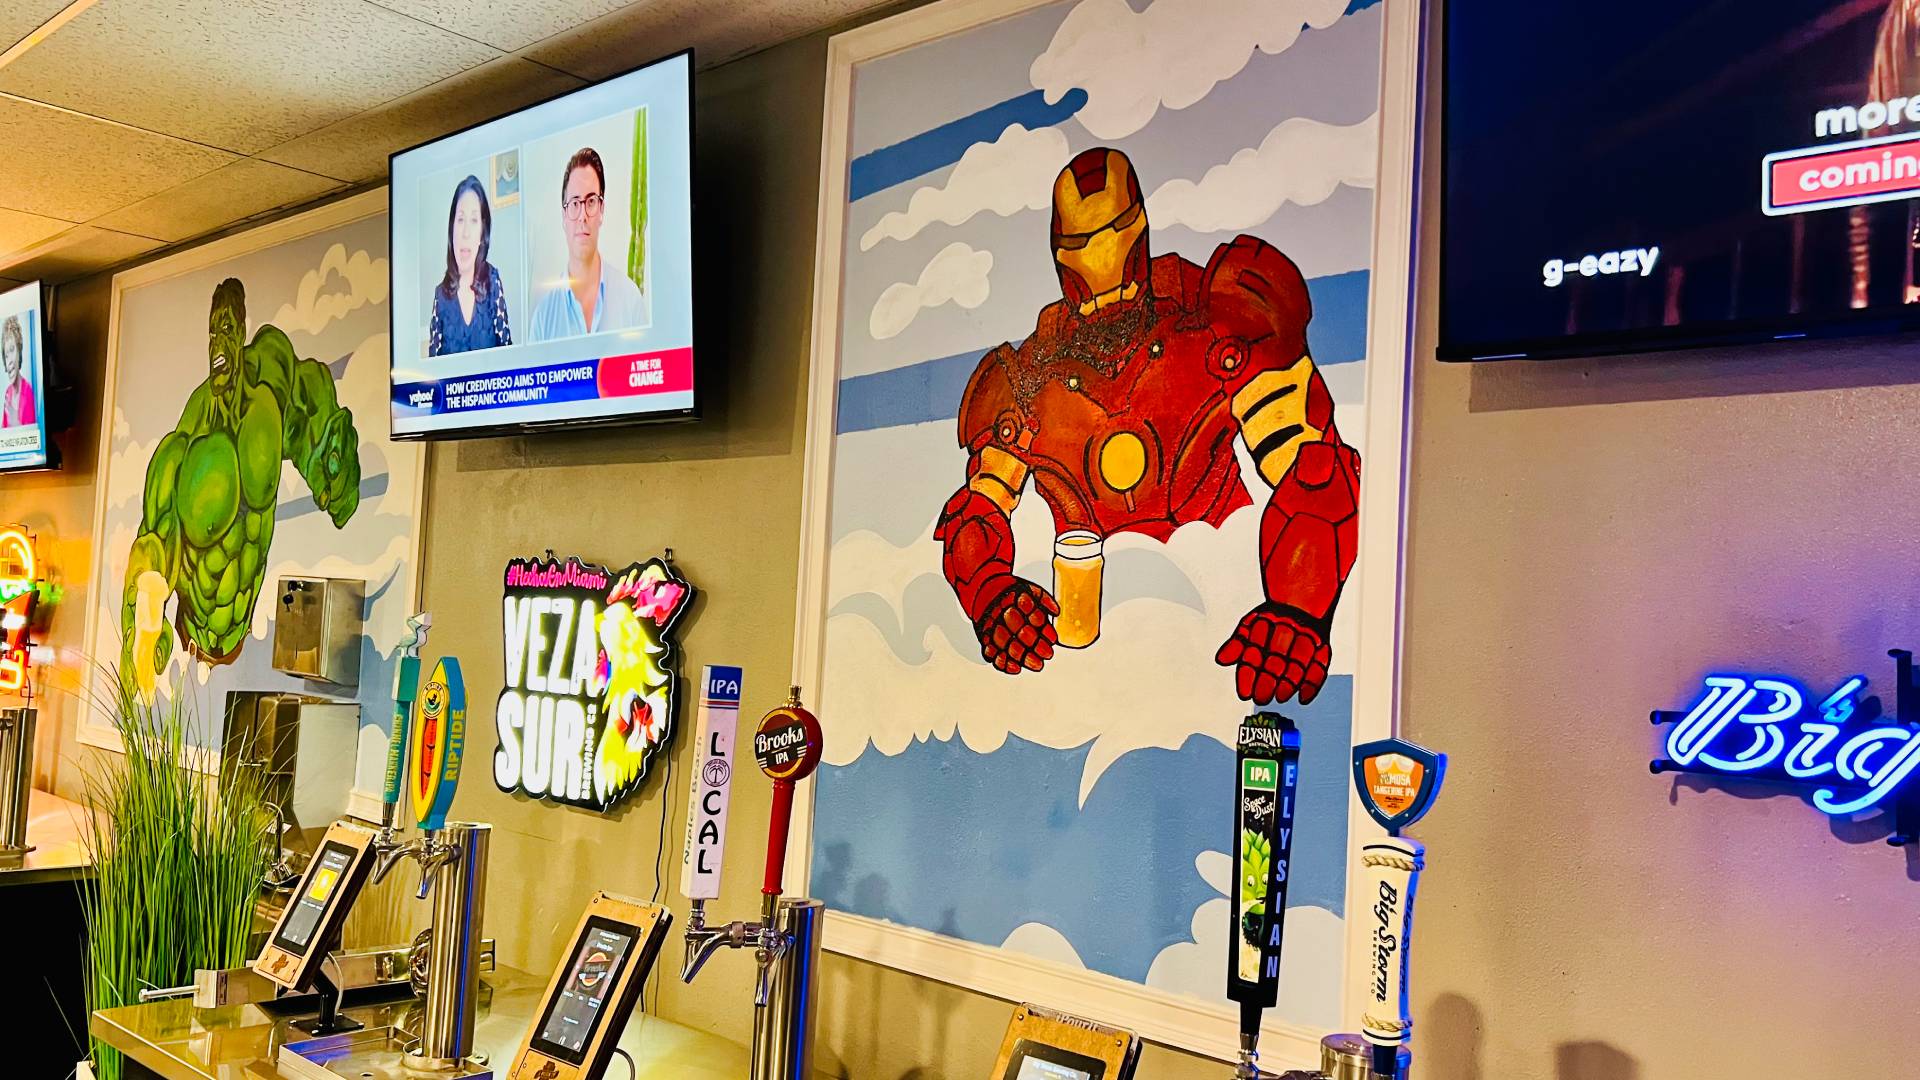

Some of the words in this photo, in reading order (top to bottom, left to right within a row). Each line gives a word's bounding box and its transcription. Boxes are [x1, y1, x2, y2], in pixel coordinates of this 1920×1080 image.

[1799, 151, 1920, 192] comin
[1542, 245, 1660, 287] g-eazy
[446, 382, 465, 396] HOW
[466, 377, 513, 393] CREDIVERSO
[513, 373, 535, 388] AIMS
[535, 371, 547, 385] TO
[549, 366, 593, 384] EMPOWER
[629, 370, 664, 387] CHANGE
[446, 396, 461, 409] THE
[461, 393, 497, 408] HISPANIC
[498, 387, 549, 404] COMMUNITY
[503, 596, 599, 698] VEZA
[711, 679, 738, 695] IPA
[444, 709, 465, 781] RIPTIDE
[494, 690, 587, 800] SUR
[755, 726, 804, 753] Brooks
[1240, 726, 1281, 748] ELYSIAN
[1666, 675, 1920, 815] Big
[692, 736, 703, 793] Beach
[775, 752, 789, 765] IPA
[1250, 766, 1272, 782] IPA
[1243, 796, 1266, 812] Space
[1253, 801, 1274, 819] Dust
[1266, 764, 1295, 978] ELYSIAN
